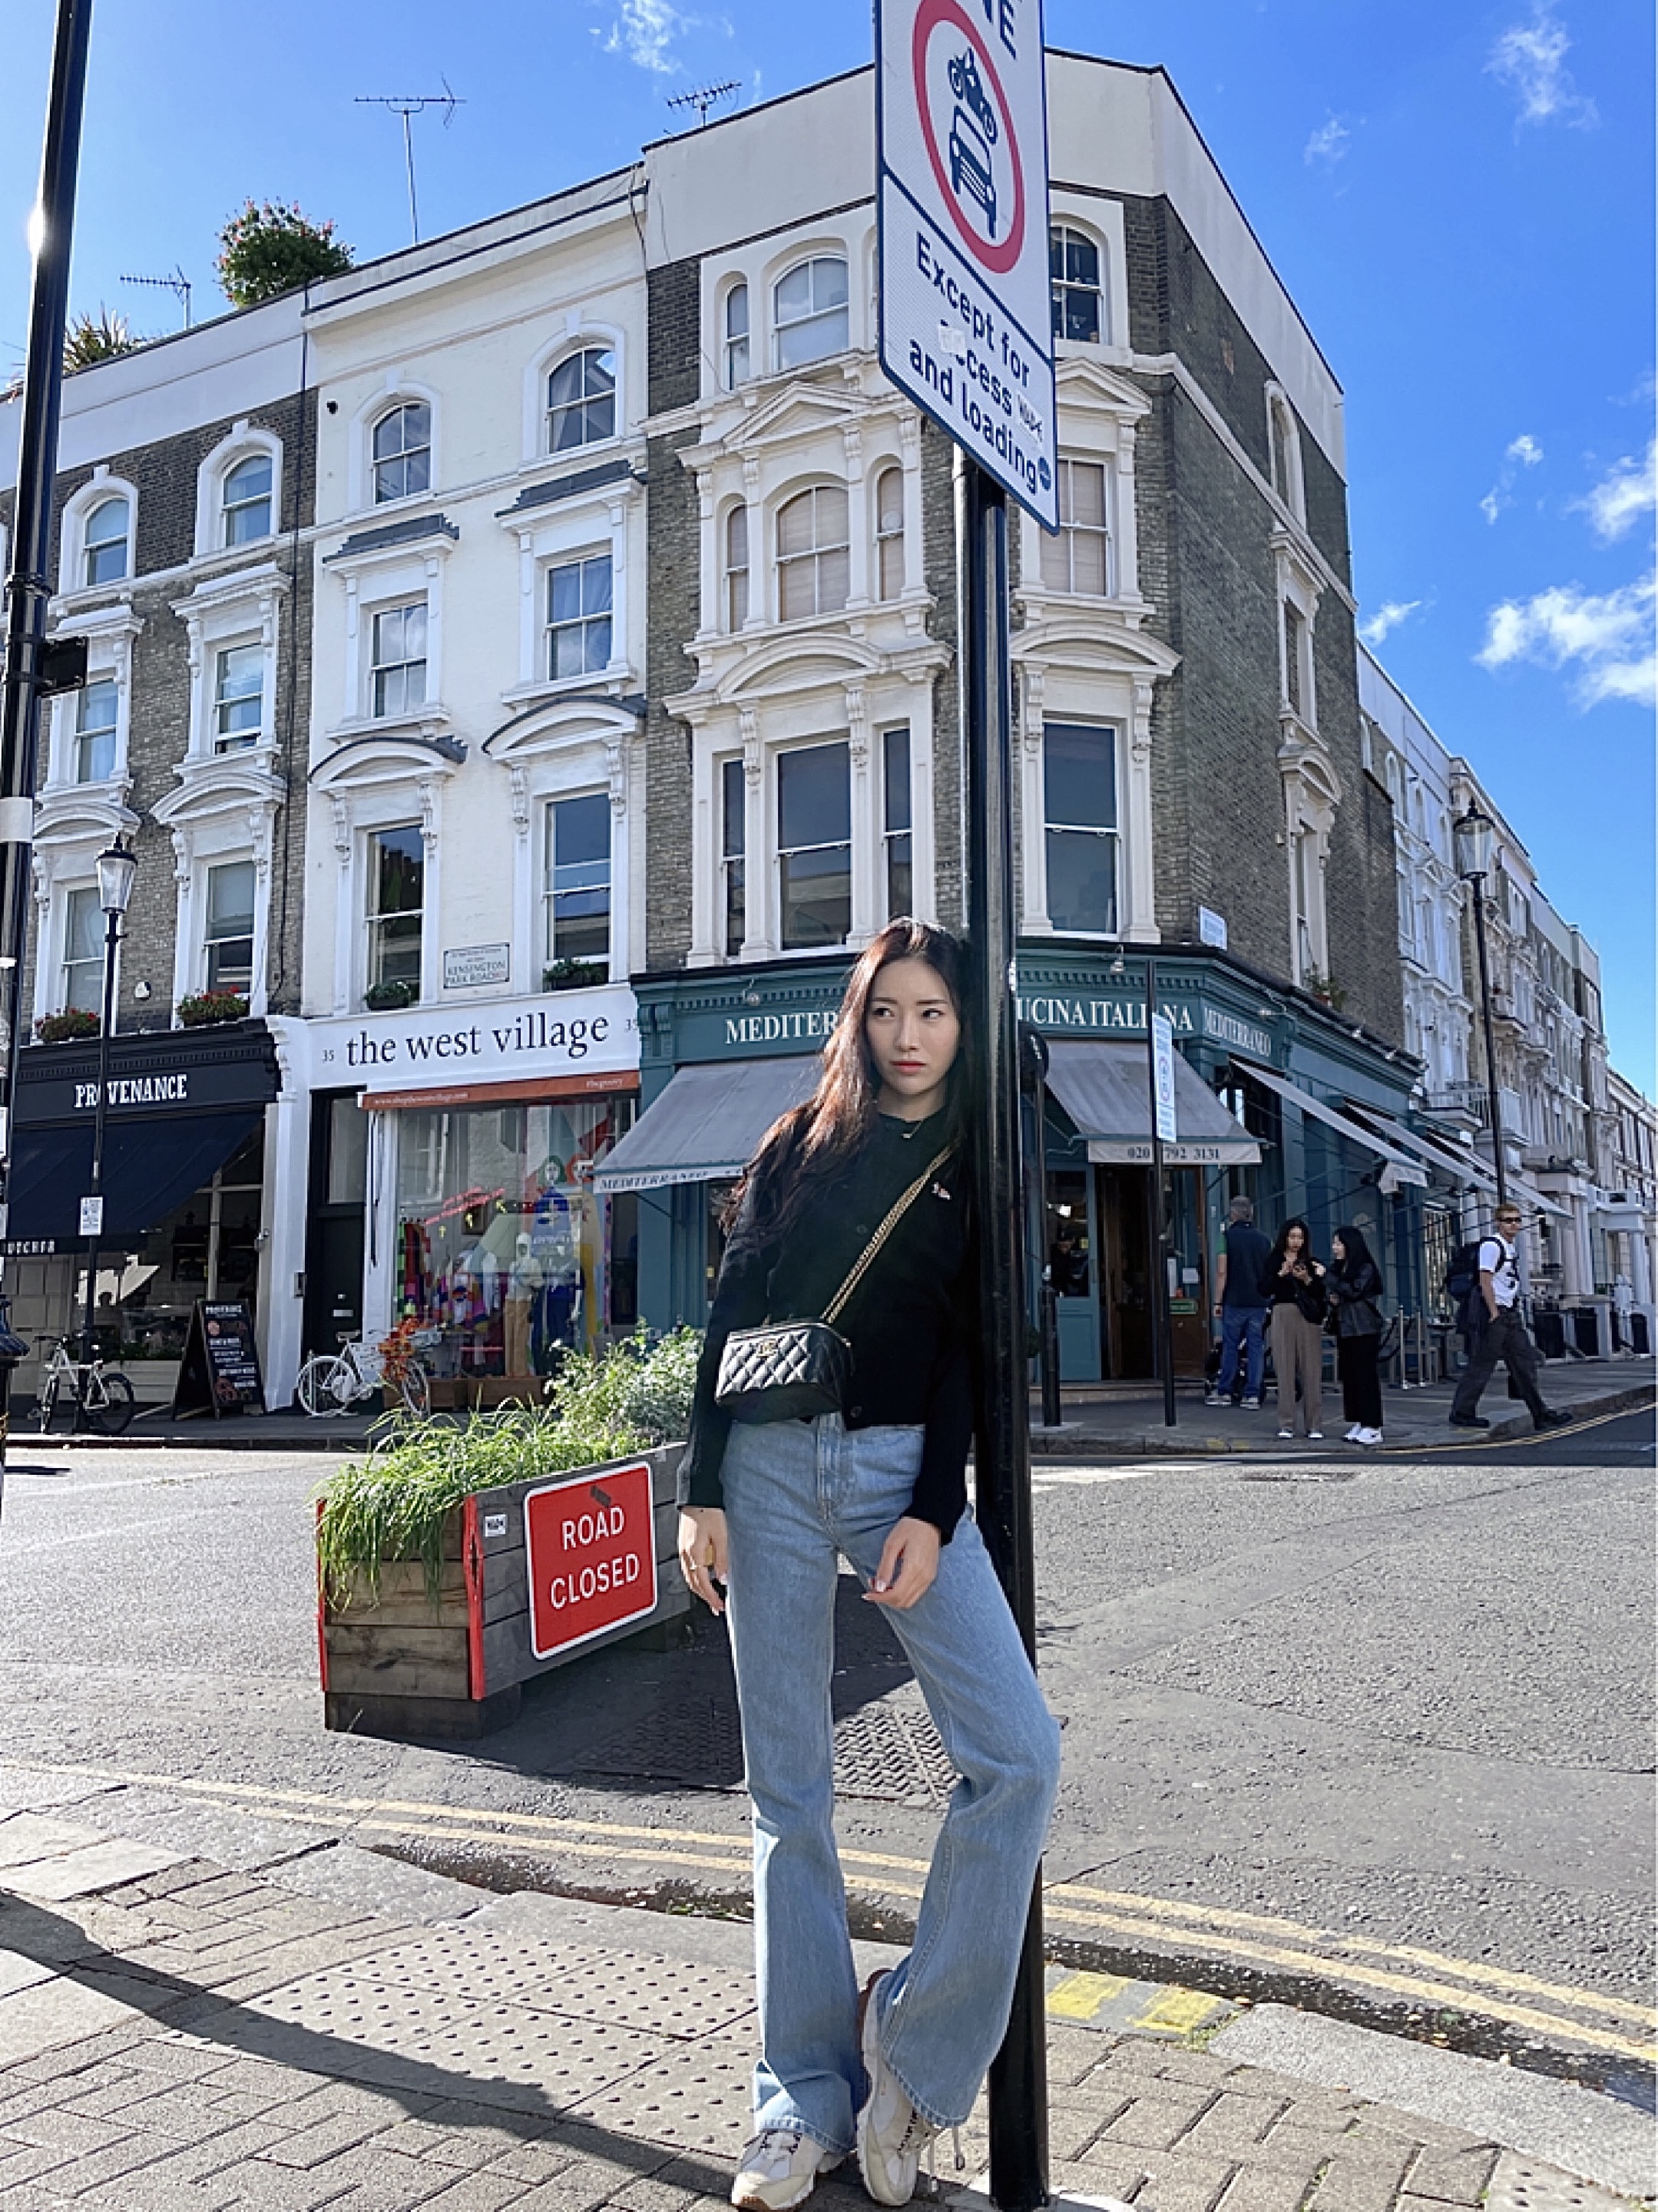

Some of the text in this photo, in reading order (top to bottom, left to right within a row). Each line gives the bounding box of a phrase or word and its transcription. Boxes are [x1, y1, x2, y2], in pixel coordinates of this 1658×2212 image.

[916, 231, 994, 351] Except
[1001, 332, 1030, 388] for
[940, 319, 1011, 416] cess
[909, 339, 954, 405] and
[961, 382, 1036, 495] loading
[346, 1030, 396, 1066] the
[405, 1026, 482, 1060] west
[492, 1012, 609, 1060] village
[1090, 1000, 1194, 1030] ITALINA
[562, 1506, 625, 1550] ROAD
[551, 1553, 640, 1610] CLOSED
